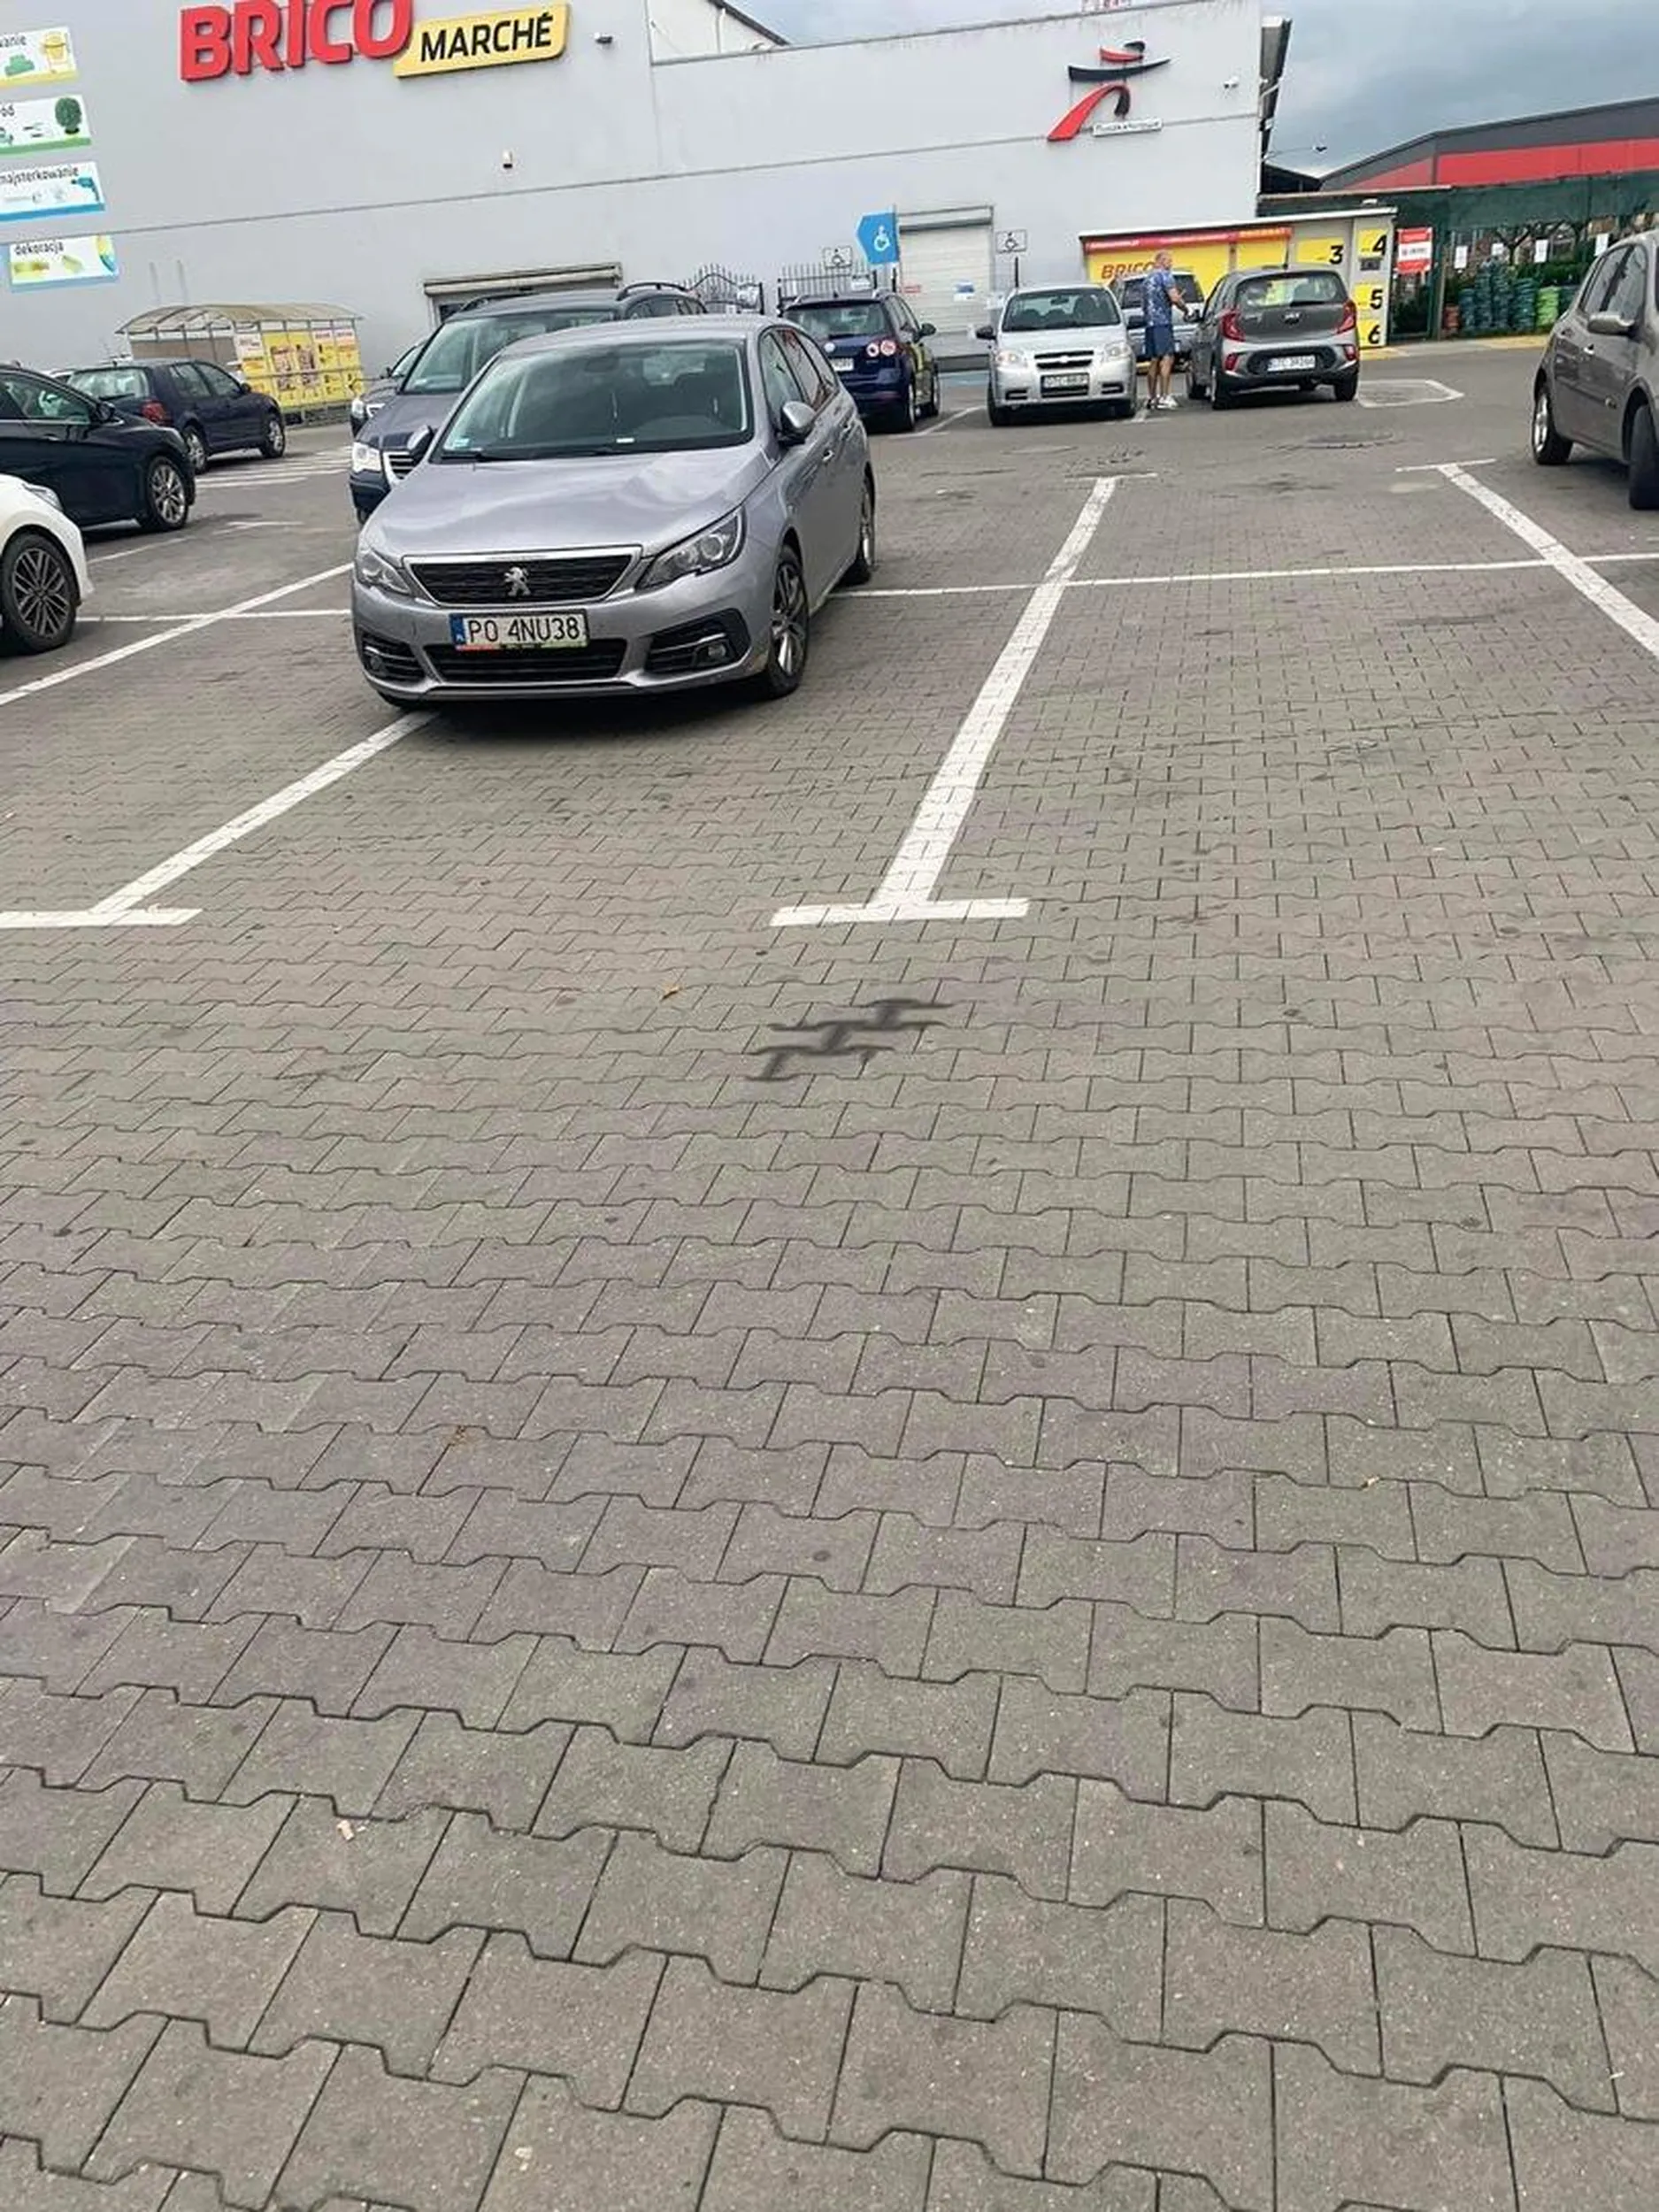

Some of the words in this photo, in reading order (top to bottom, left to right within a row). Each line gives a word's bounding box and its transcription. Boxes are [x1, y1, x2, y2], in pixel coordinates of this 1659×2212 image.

[180, 0, 413, 81] BRICO
[420, 12, 553, 62] MARCHÉ
[14, 241, 64, 255] dekoracja
[1329, 244, 1344, 265] 3
[1372, 234, 1387, 256] 4
[1371, 288, 1383, 310] 5
[1368, 325, 1381, 344] 6
[507, 616, 580, 641] 4NU38
